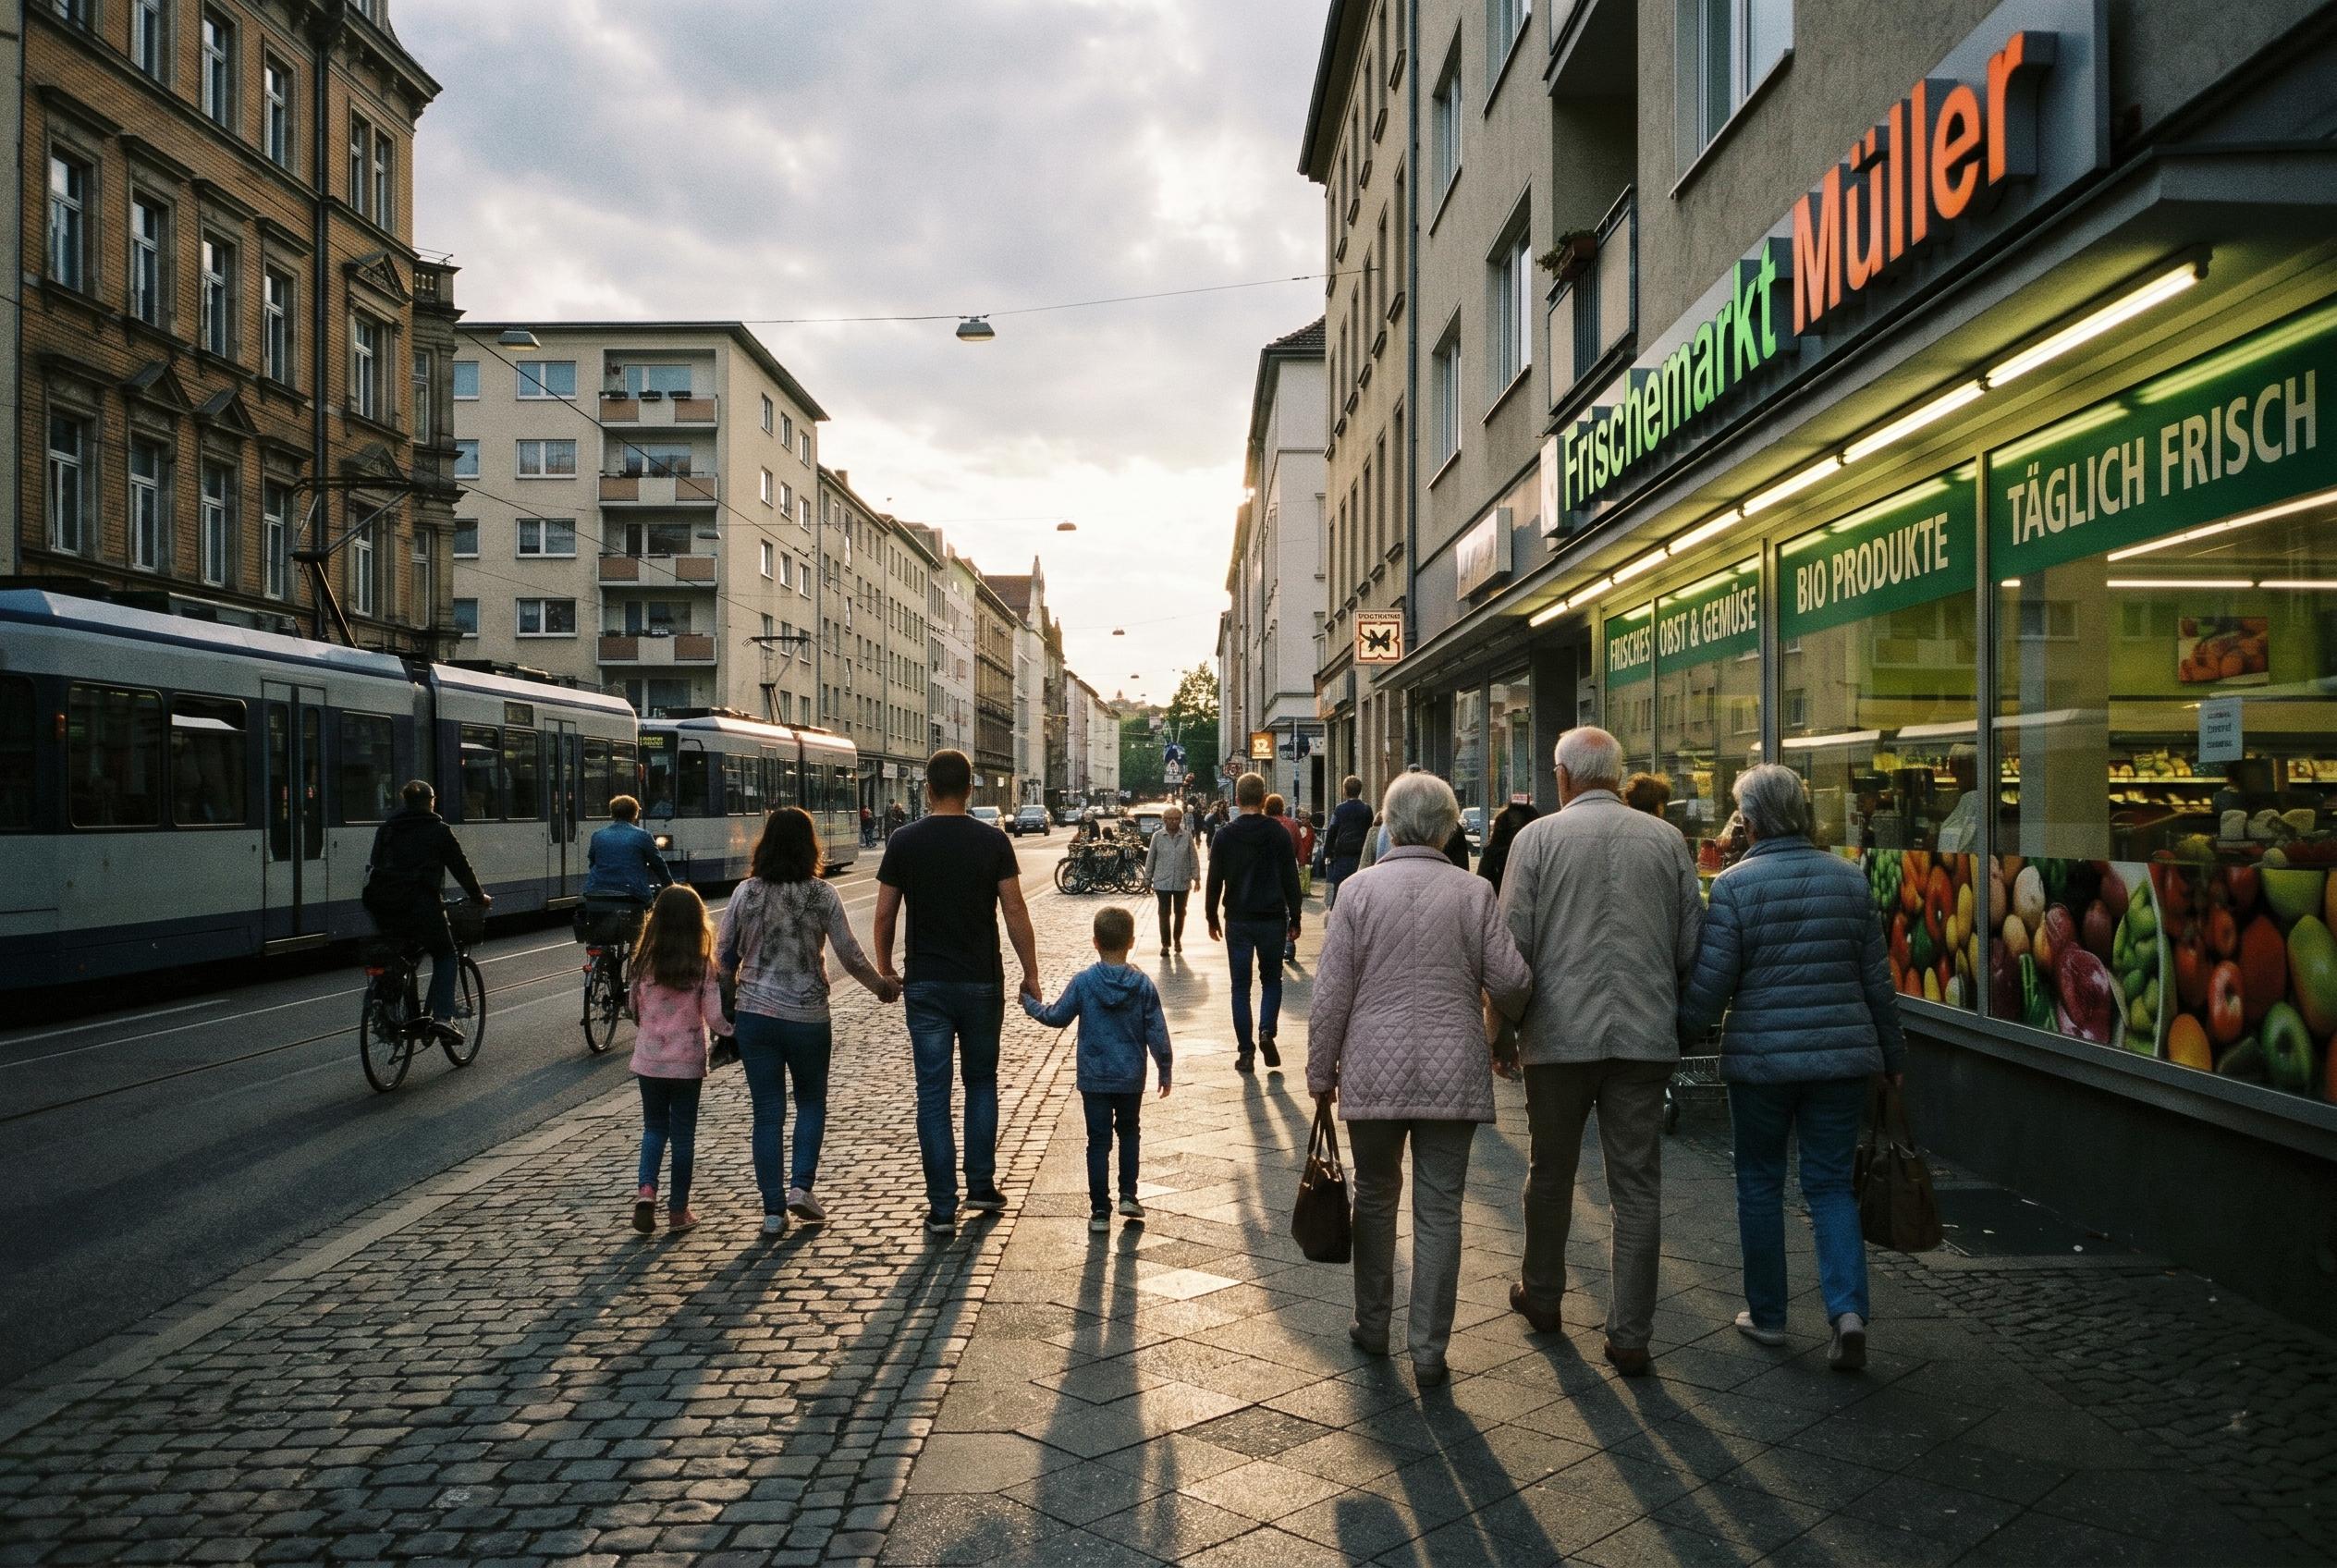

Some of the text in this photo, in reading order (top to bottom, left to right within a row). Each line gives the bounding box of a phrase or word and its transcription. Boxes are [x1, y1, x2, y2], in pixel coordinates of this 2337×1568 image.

[1564, 31, 2025, 512] Frischemarkt Müller
[2007, 370, 2317, 545] TÄGLICH FRISCH
[1610, 582, 1756, 672] FRISCHES OBST & GEMÜSE
[1796, 512, 1949, 614] BIO PRODUKTE
